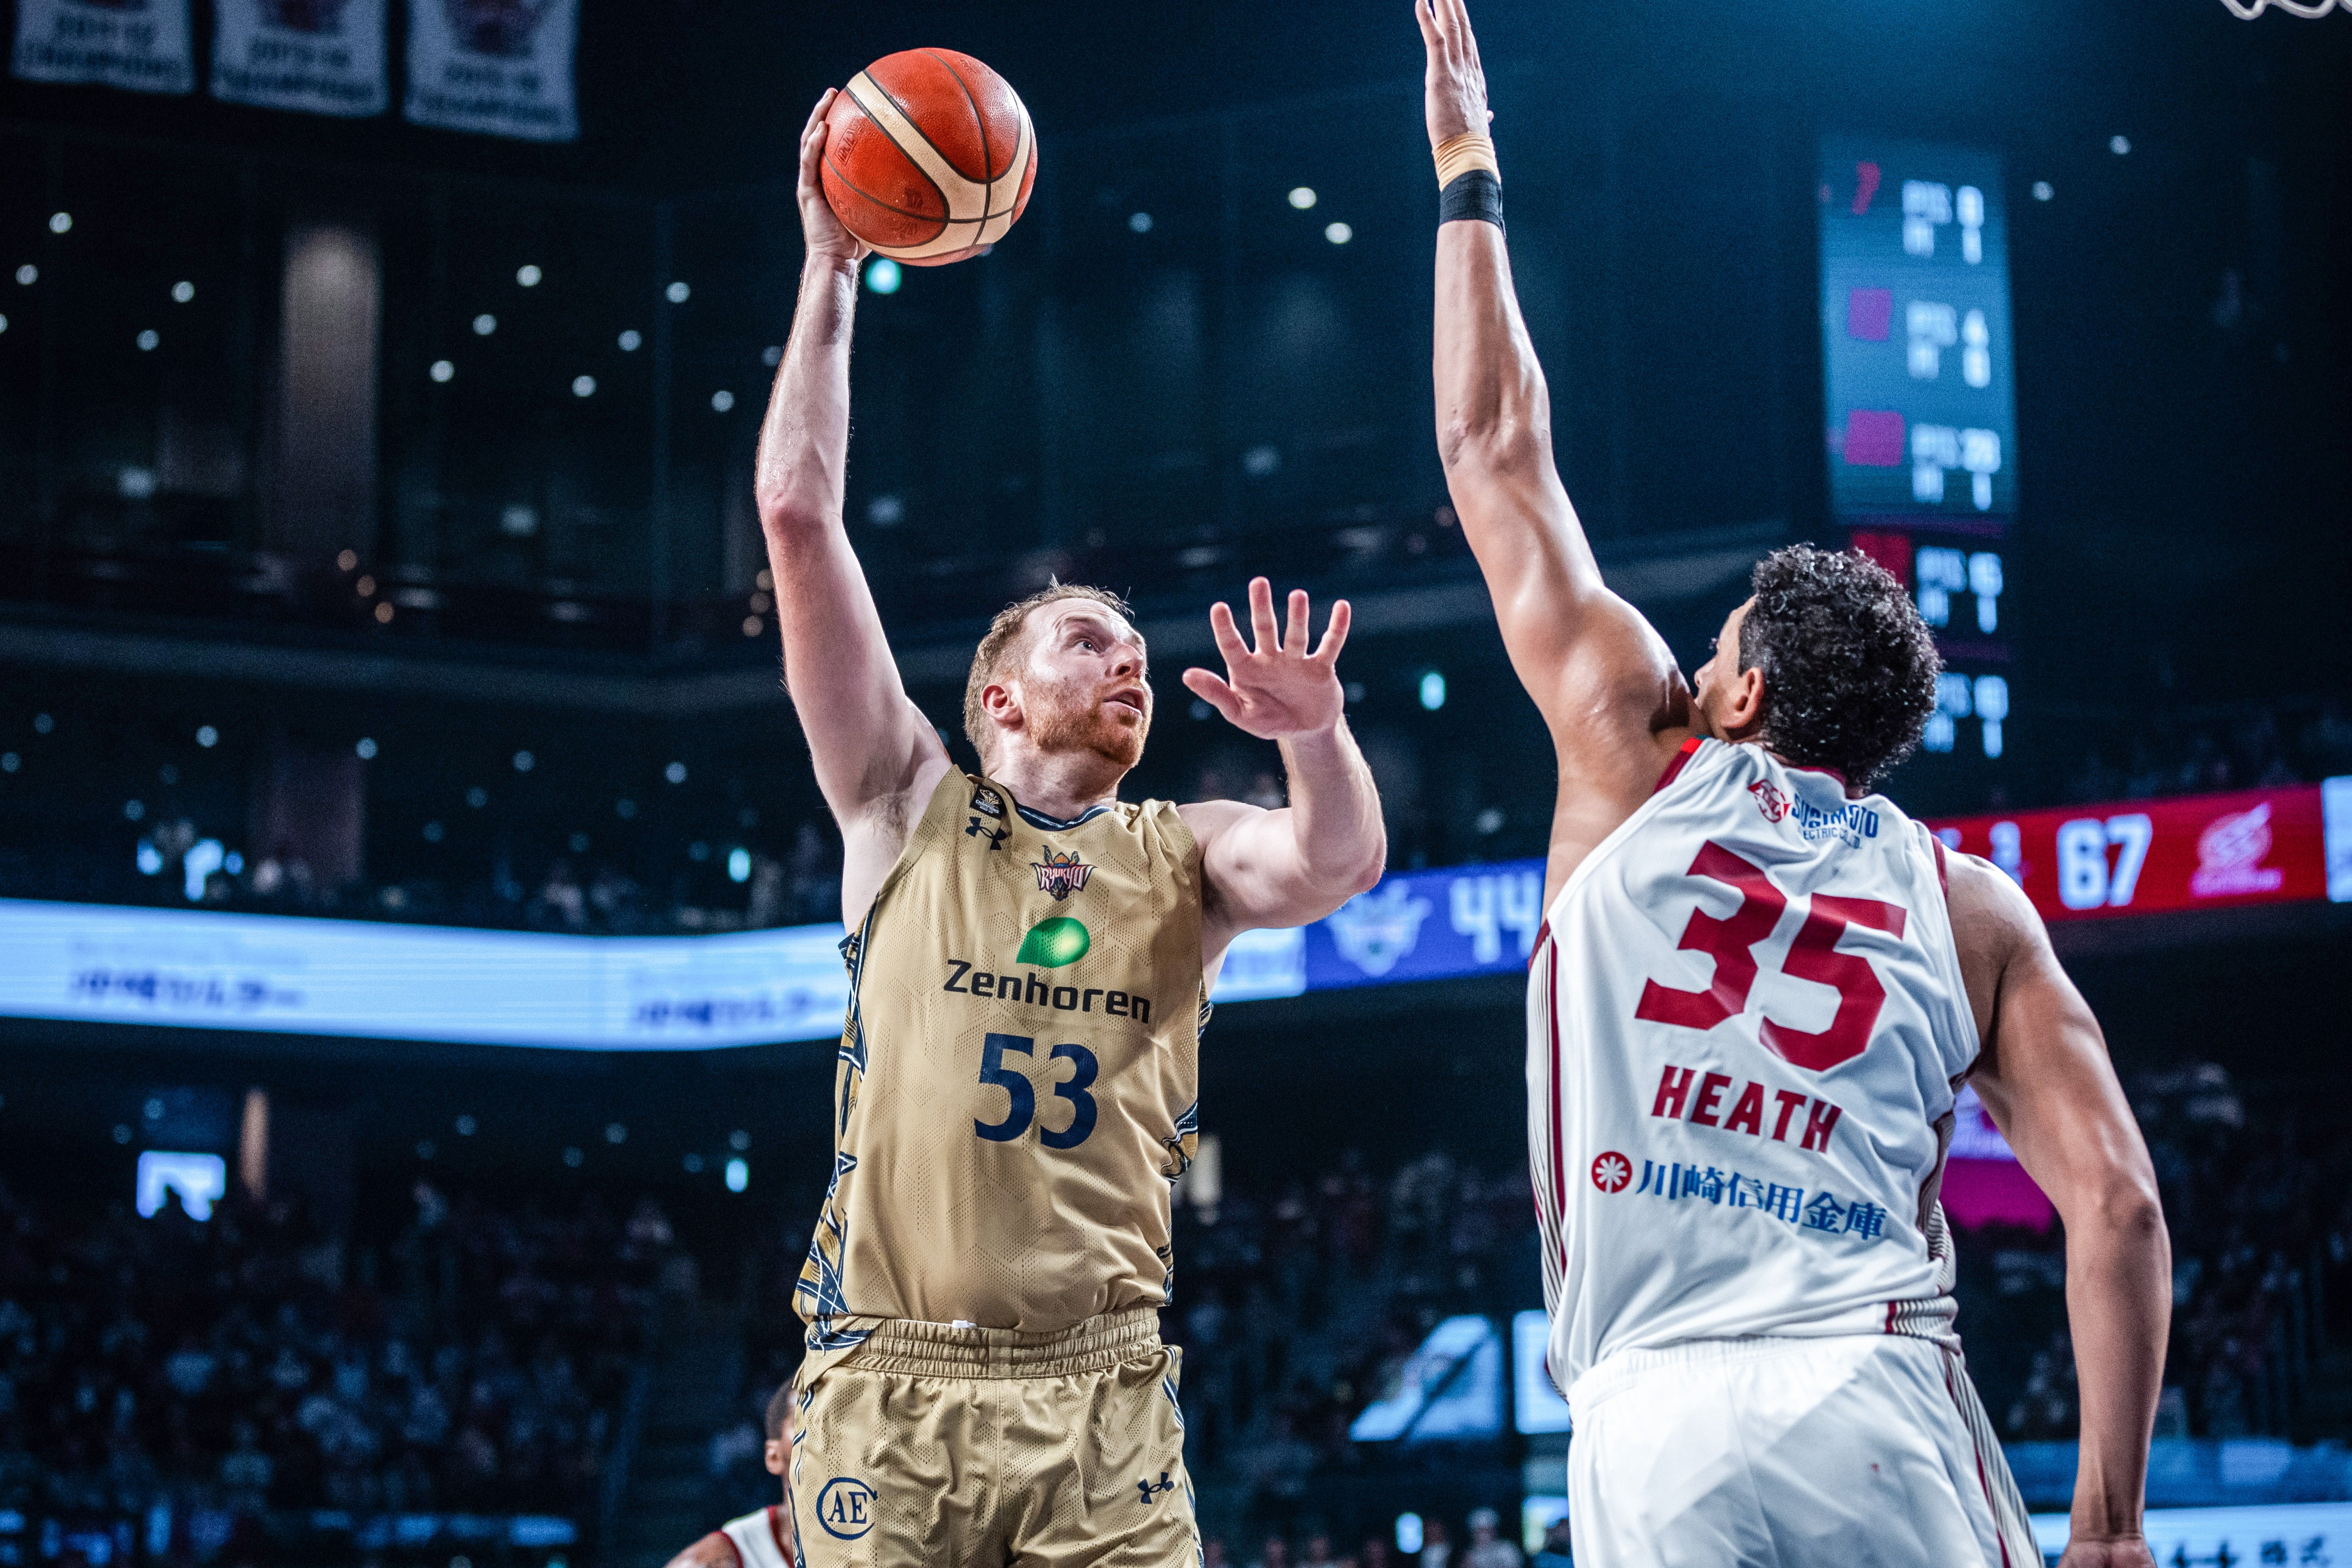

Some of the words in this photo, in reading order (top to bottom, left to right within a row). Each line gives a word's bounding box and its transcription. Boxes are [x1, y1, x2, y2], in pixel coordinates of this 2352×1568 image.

[975, 799, 999, 814] CHAMPIONS
[1040, 865, 1086, 890] RYUKYU
[2056, 813, 2153, 910] 67
[1449, 870, 1543, 964] 44
[1635, 840, 1907, 1073] 35
[943, 959, 1151, 1024] Zenhoren
[974, 1032, 1099, 1150] 53
[1651, 1065, 1843, 1153] HEATH
[1636, 1159, 1887, 1240] 川崎信用金庫
[827, 1491, 867, 1524] AE
